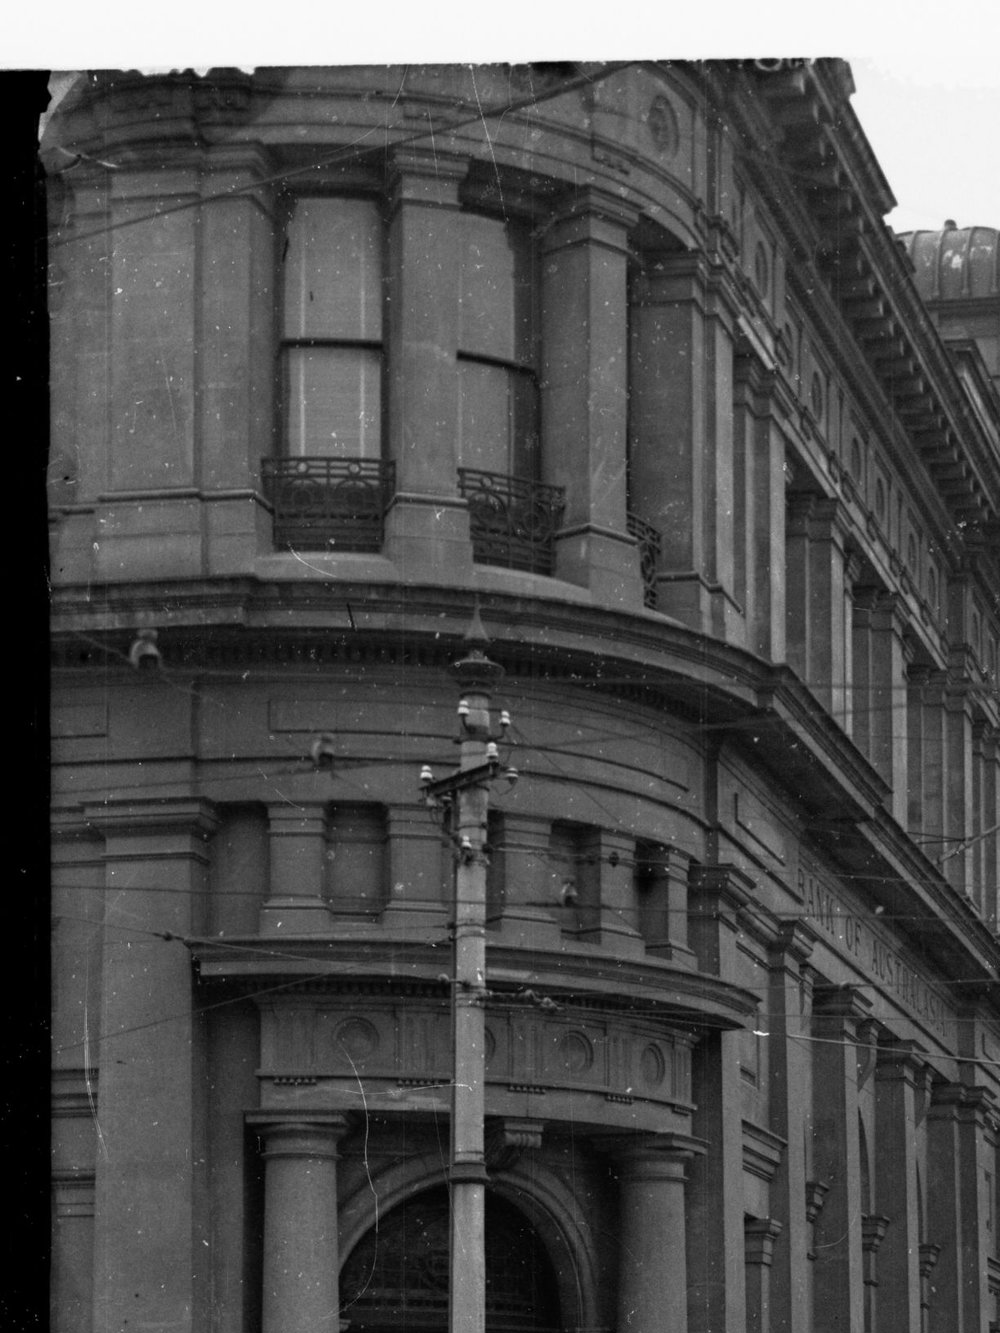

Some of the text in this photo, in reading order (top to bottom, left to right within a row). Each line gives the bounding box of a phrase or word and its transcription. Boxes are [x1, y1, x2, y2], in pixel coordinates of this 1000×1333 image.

[797, 866, 948, 1038] BANK OF AUSTRALASIA
